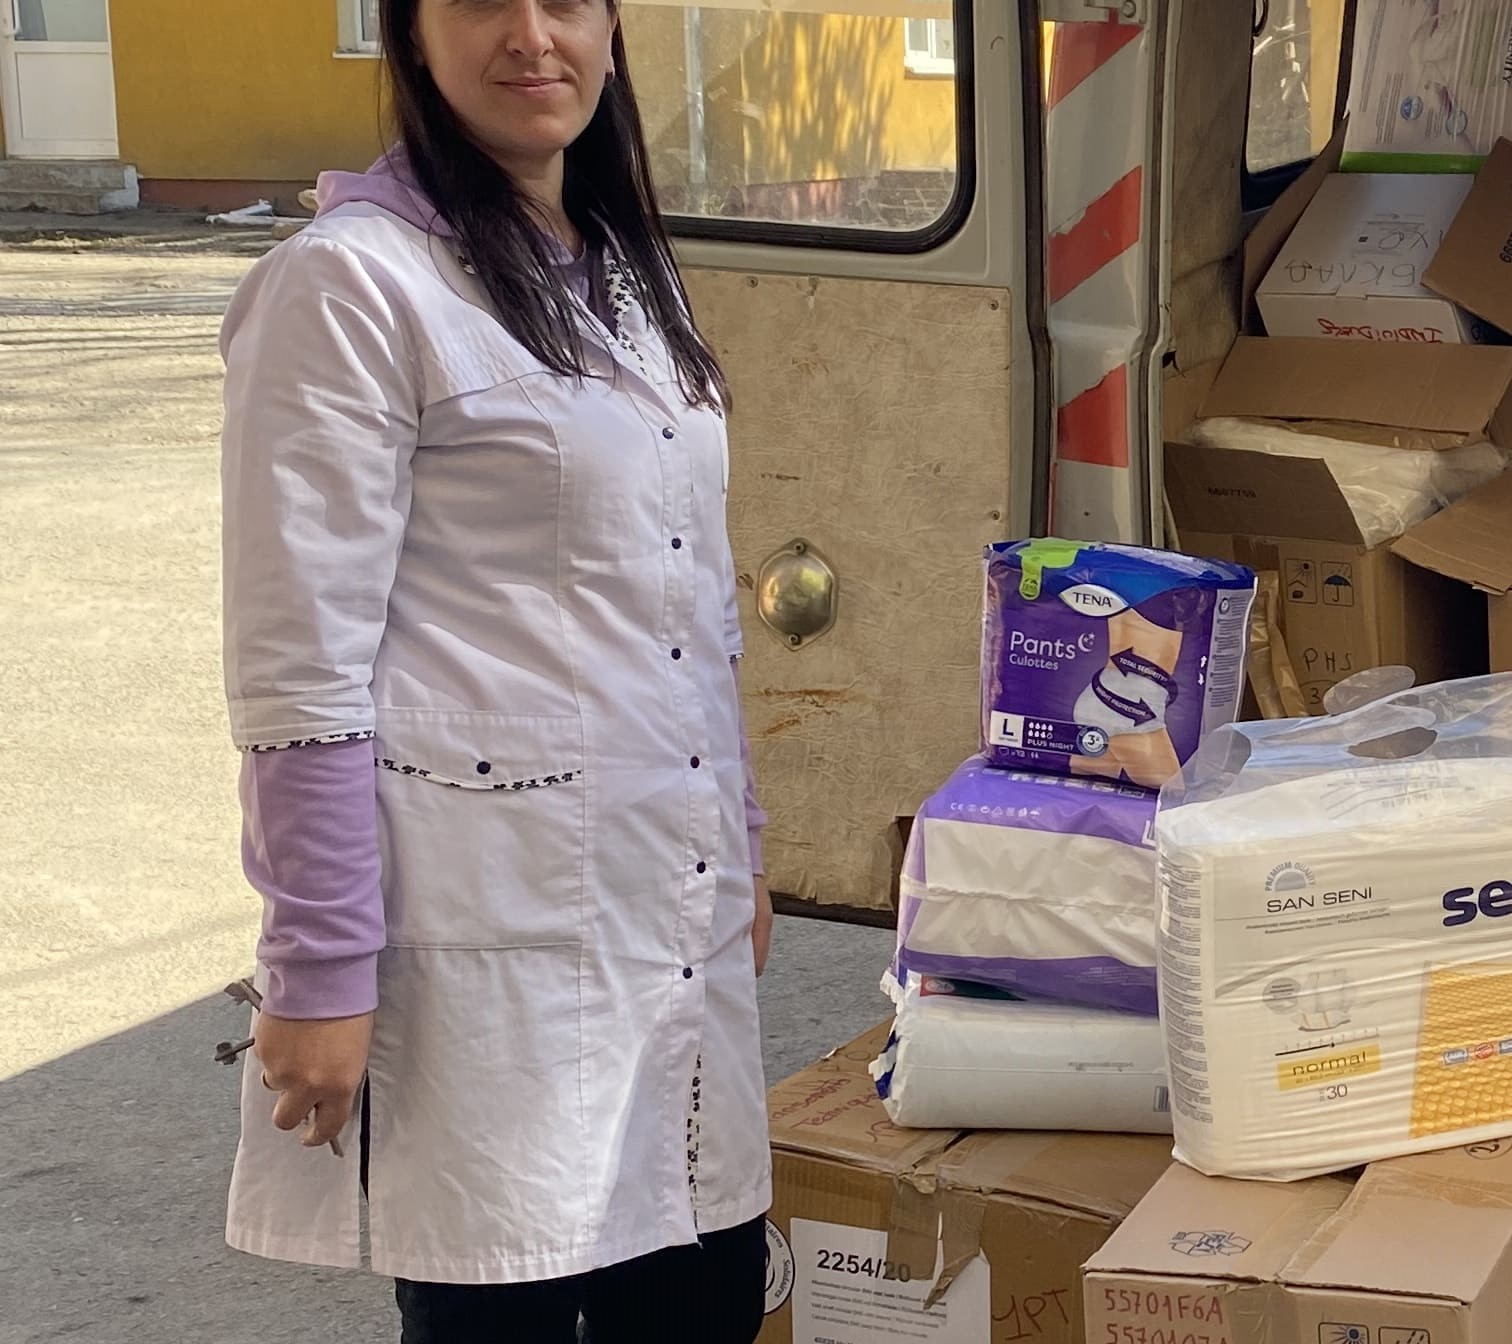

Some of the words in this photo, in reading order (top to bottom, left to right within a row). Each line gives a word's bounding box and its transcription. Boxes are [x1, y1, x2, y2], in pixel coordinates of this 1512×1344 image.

[1072, 591, 1113, 609] TENA
[1010, 631, 1076, 660] Pants
[1009, 654, 1059, 671] Culottes
[1303, 647, 1353, 673] PHS
[1002, 718, 1014, 737] L
[1027, 738, 1048, 748] PLUS
[1264, 861, 1292, 892] PREMIUM
[1266, 895, 1315, 913] SAN
[1322, 886, 1373, 905] SENI
[1292, 1051, 1367, 1077] normal
[1326, 1083, 1348, 1101] 30
[816, 1248, 912, 1283] 2254/20
